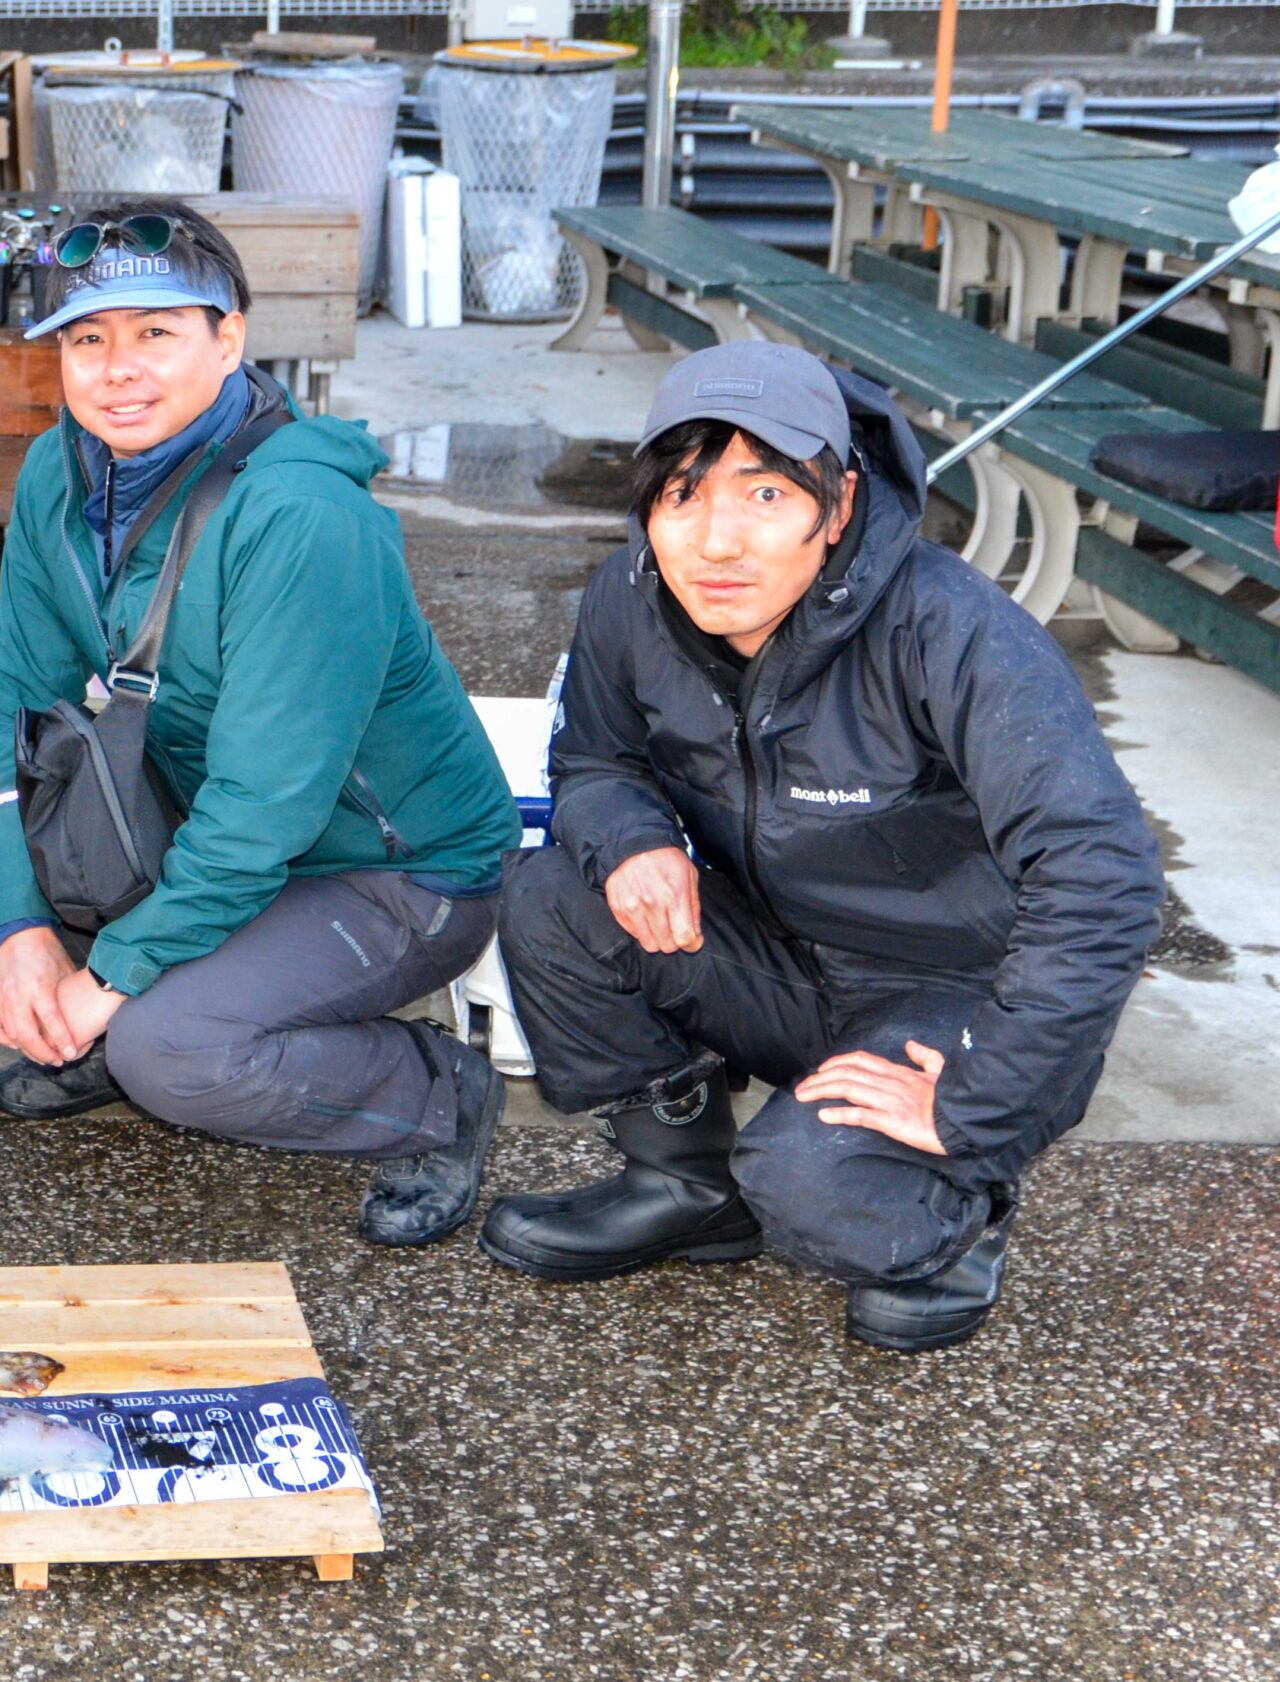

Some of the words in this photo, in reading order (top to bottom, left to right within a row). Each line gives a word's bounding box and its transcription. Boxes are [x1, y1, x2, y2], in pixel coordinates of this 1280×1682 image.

[112, 1396, 156, 1408] SIDE
[158, 1393, 239, 1405] MARINA
[254, 1424, 346, 1493] 8
